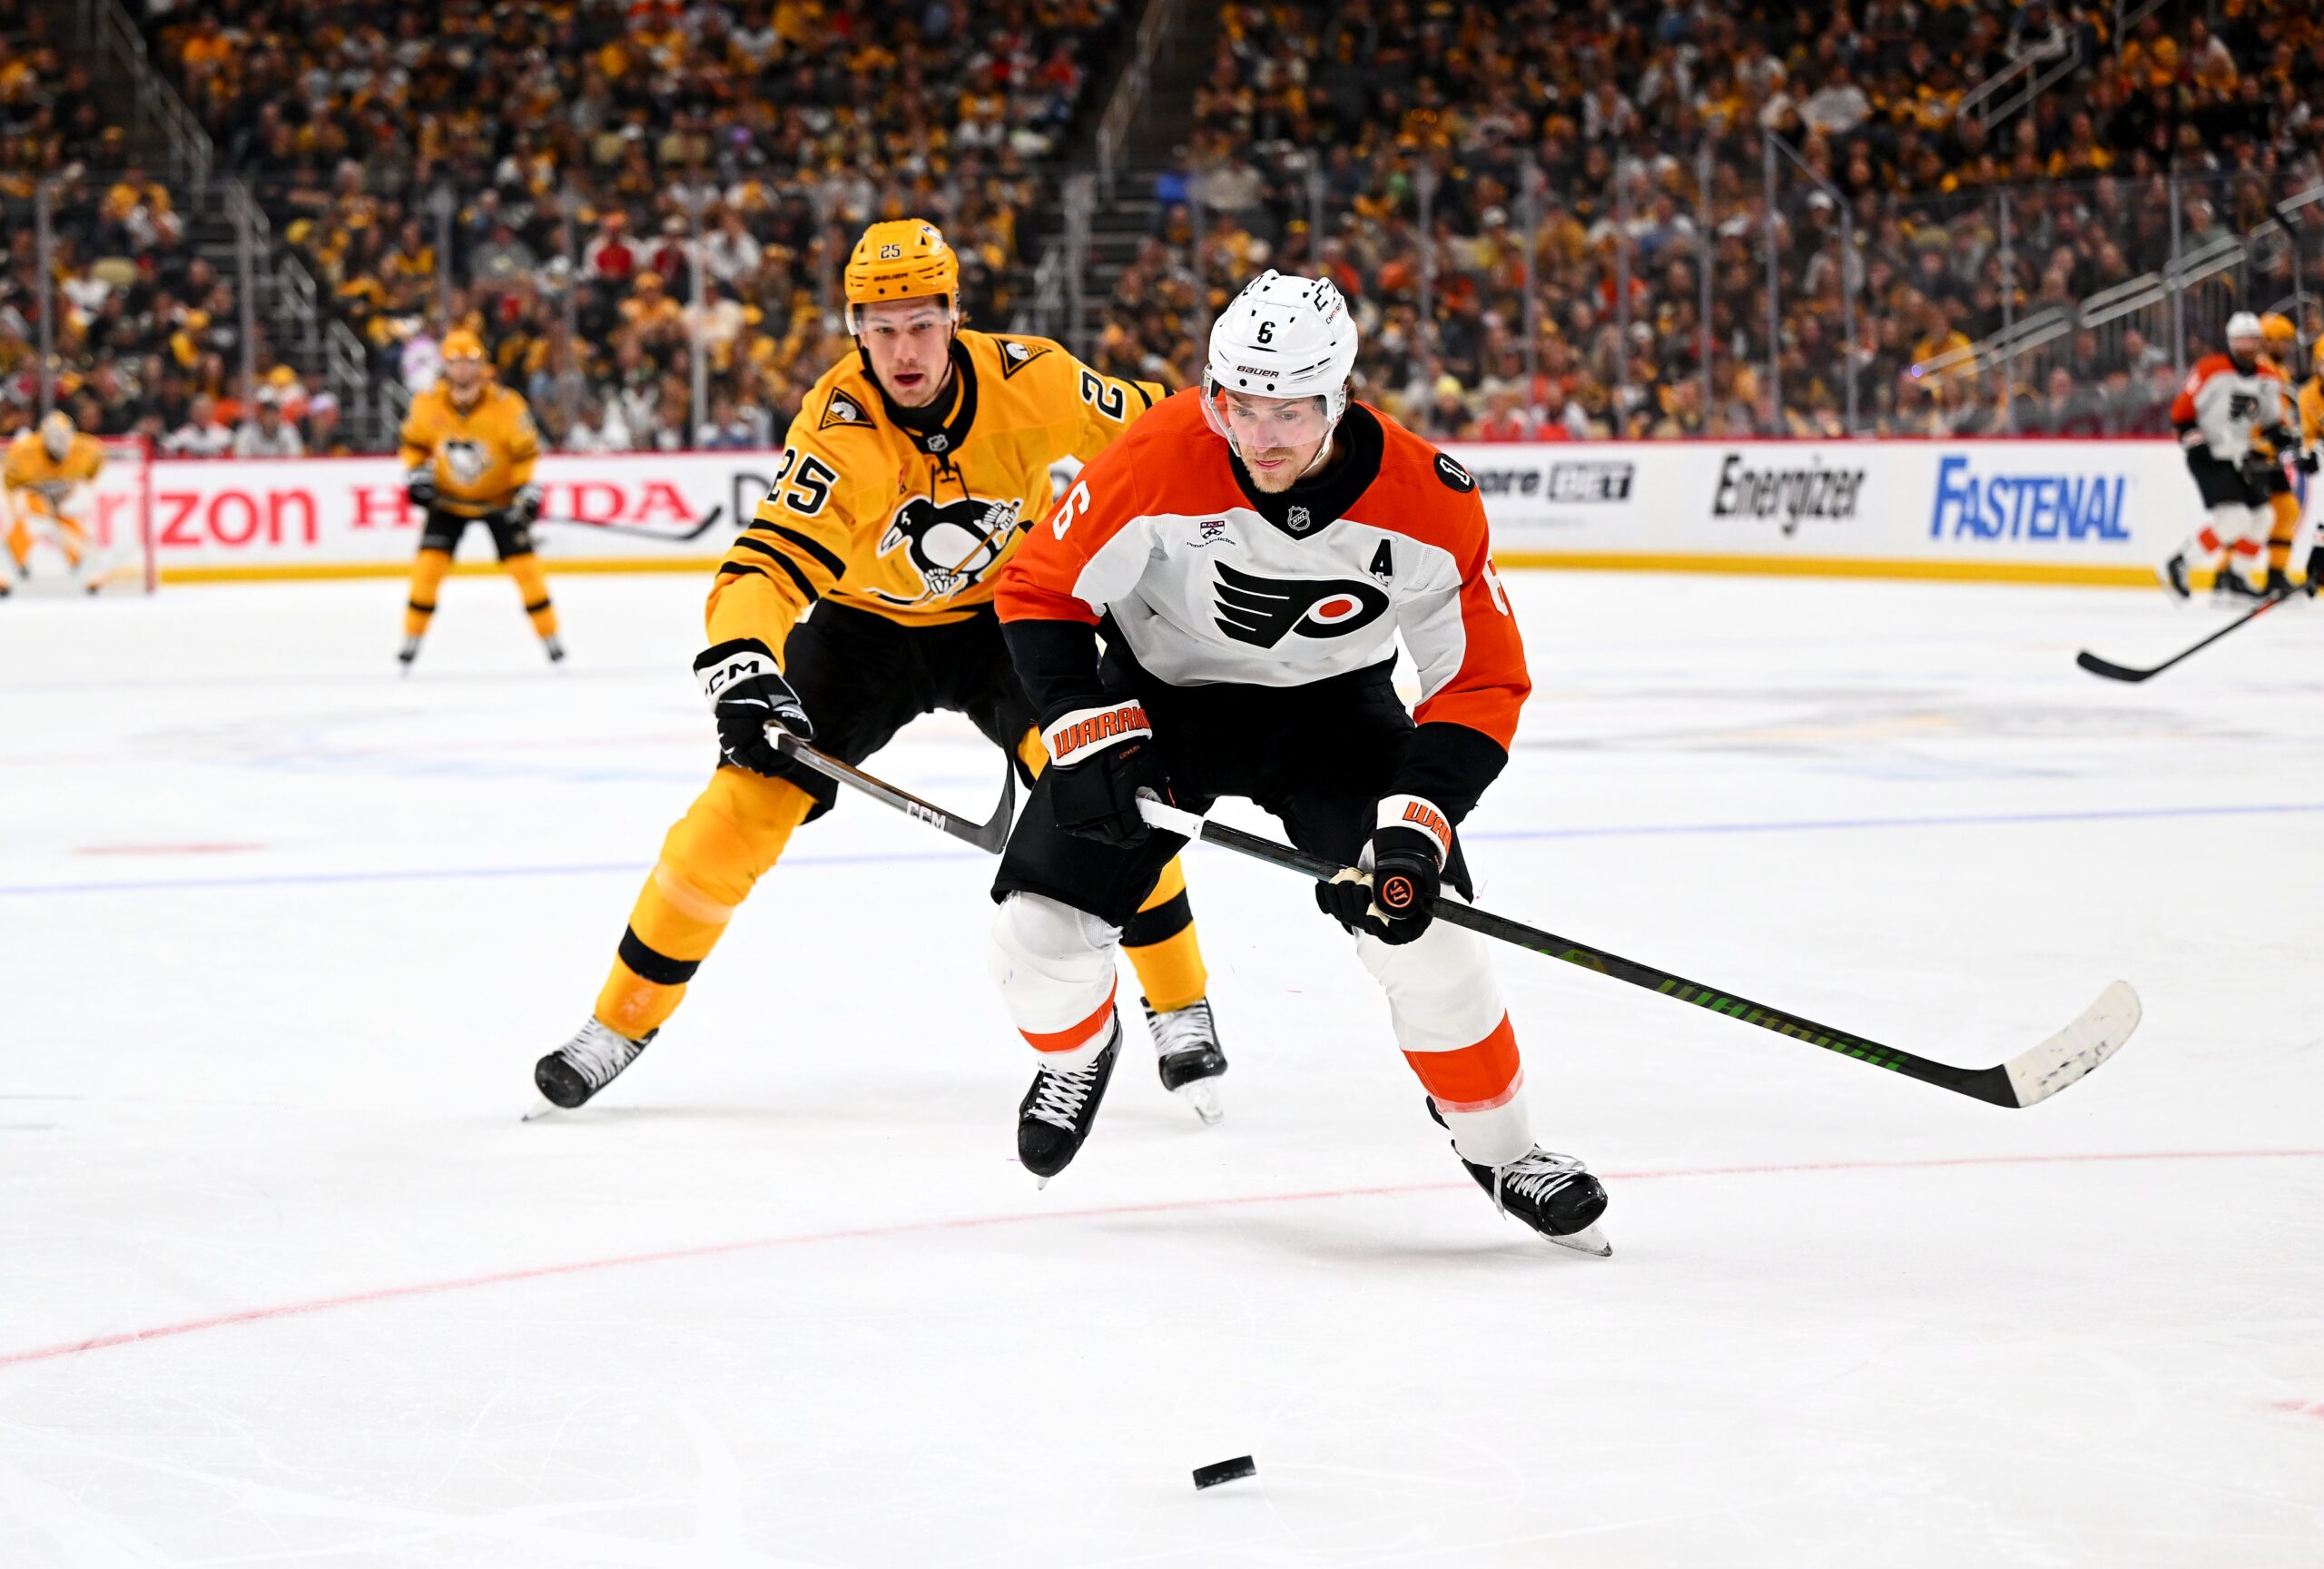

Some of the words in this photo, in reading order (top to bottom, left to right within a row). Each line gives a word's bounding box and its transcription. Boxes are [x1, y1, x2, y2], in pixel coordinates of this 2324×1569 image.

[881, 243, 901, 261] 25
[1256, 321, 1276, 344] 6
[1079, 367, 1126, 424] 2
[764, 446, 841, 517] 25
[1712, 452, 1866, 537] Energizer
[1052, 480, 1091, 541] 6
[1369, 538, 1393, 579] A
[704, 660, 760, 696] CM
[906, 800, 947, 832] CCM
